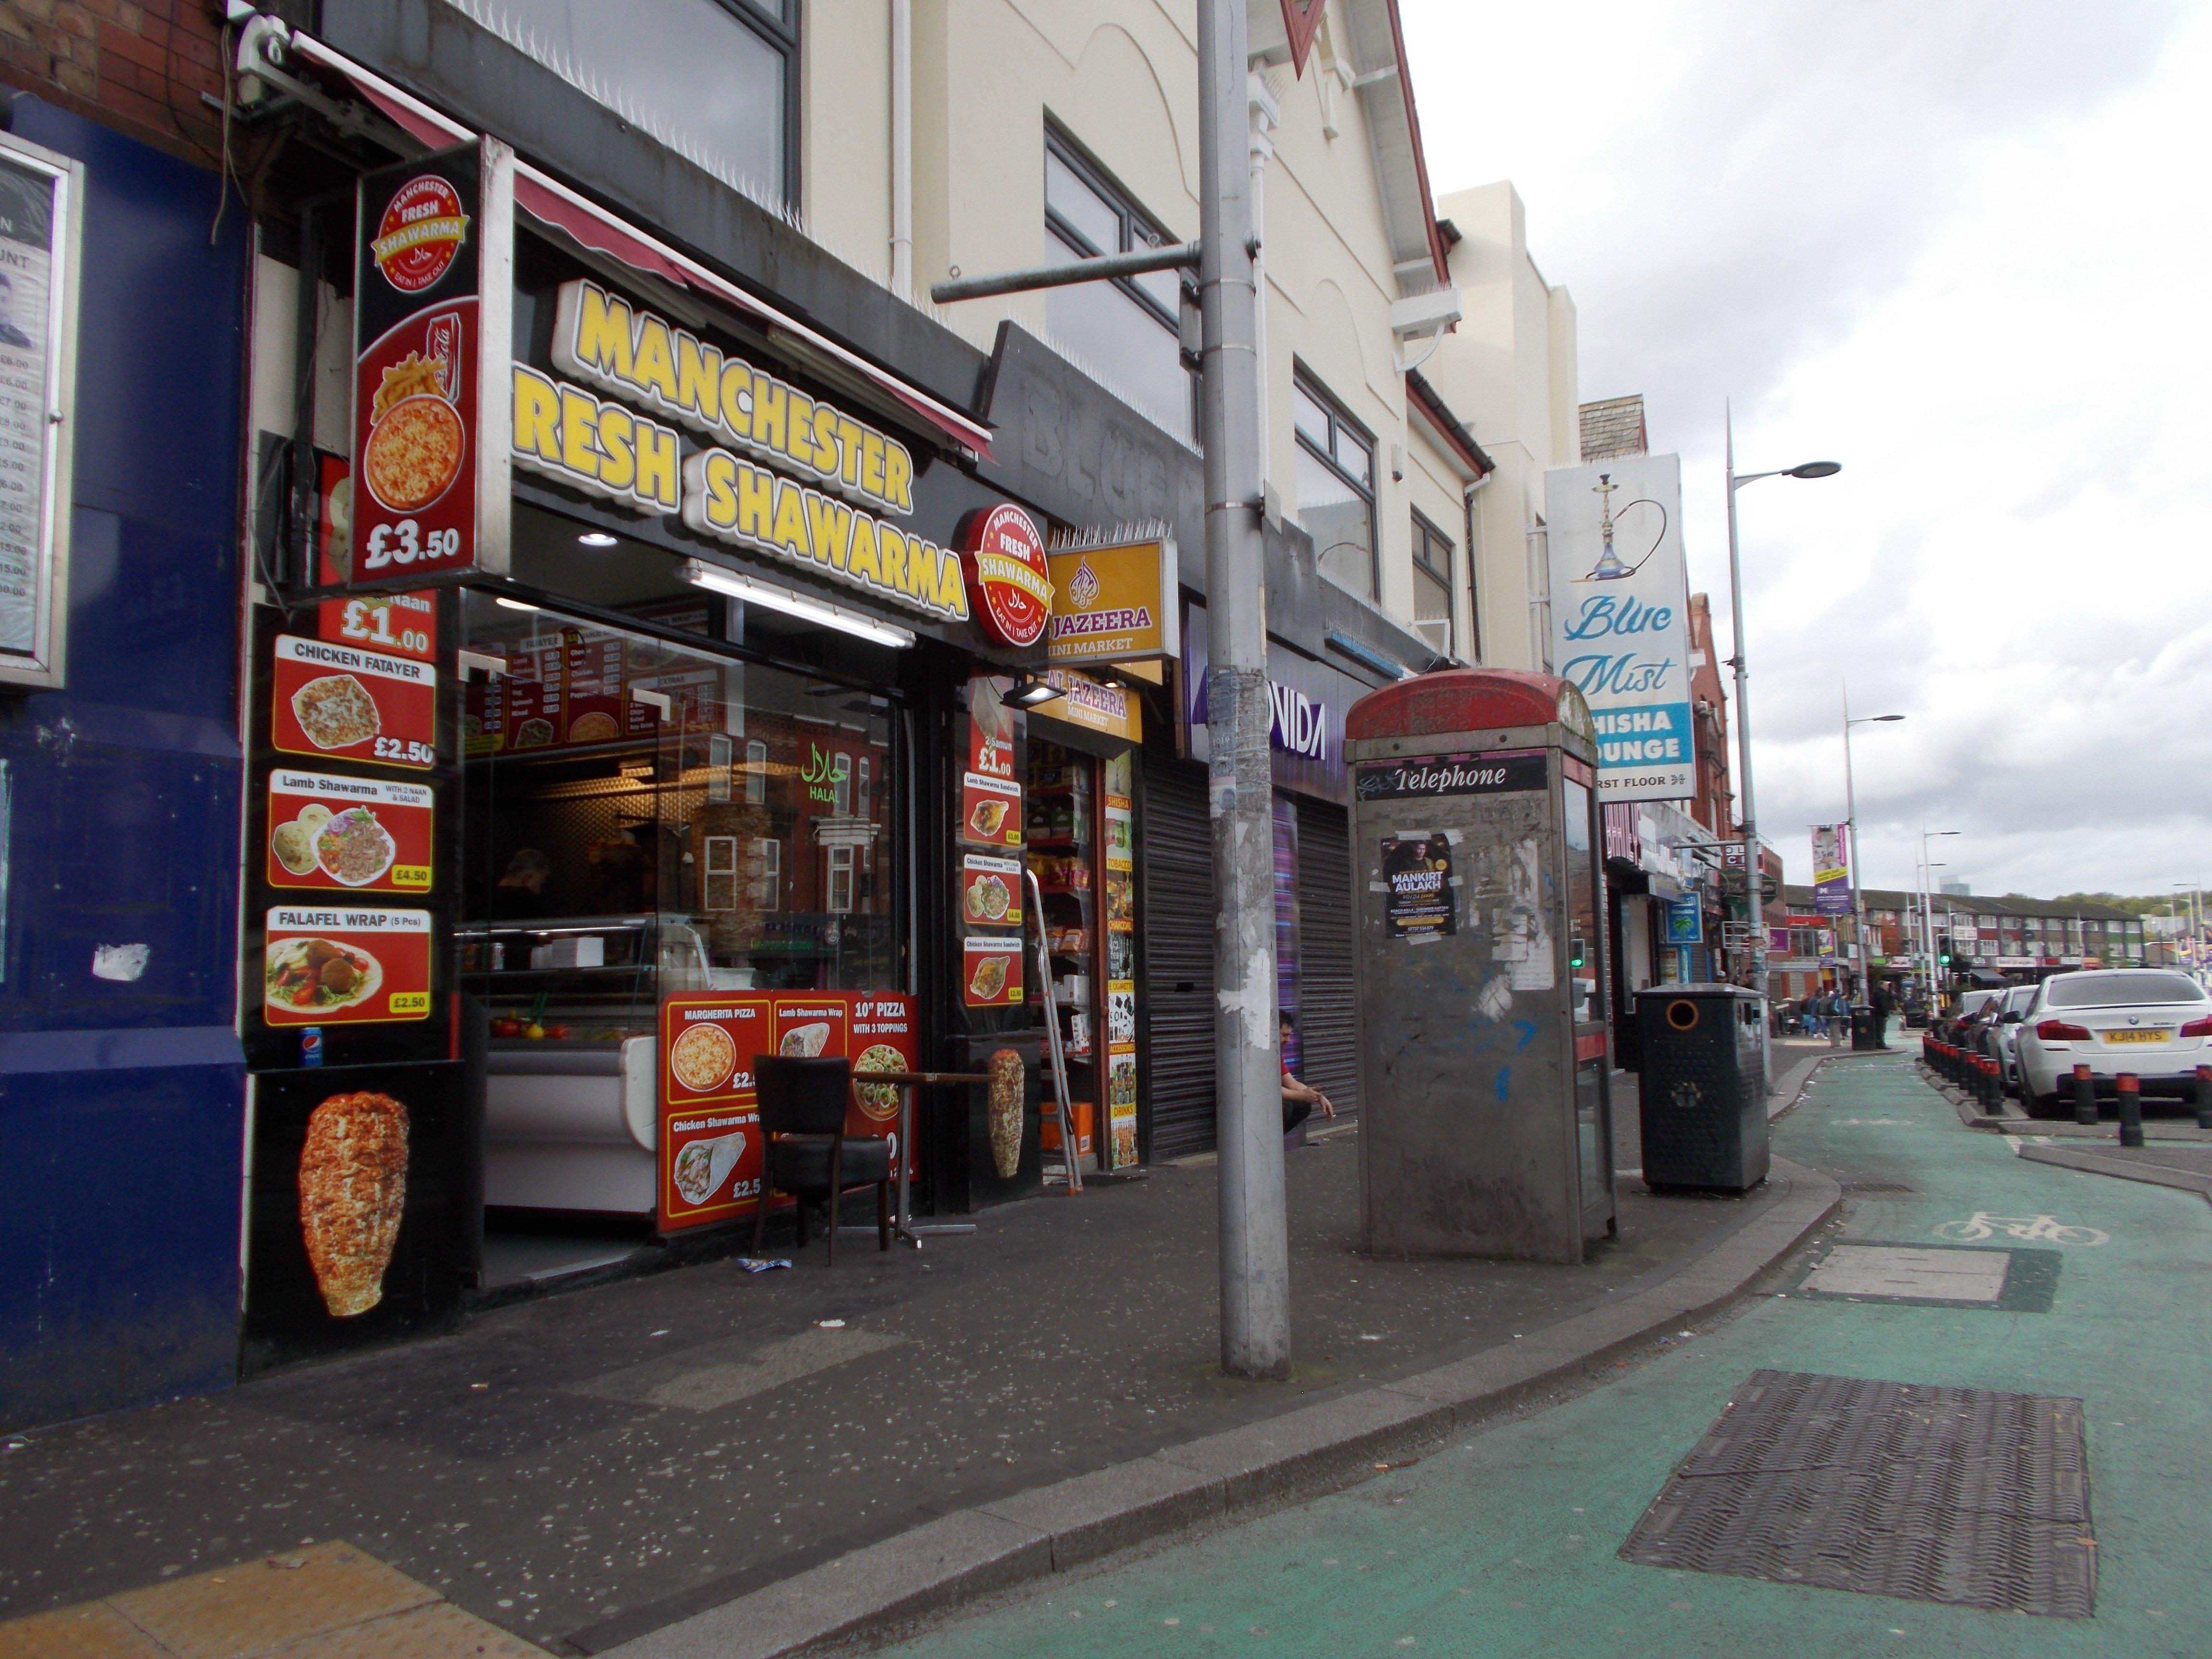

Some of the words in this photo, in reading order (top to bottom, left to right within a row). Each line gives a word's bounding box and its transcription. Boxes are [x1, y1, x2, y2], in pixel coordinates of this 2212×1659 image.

[394, 181, 449, 212] MANCHESTER
[402, 200, 438, 223] FRESH
[380, 221, 459, 255] SHAWARMA
[418, 274, 432, 284] TAKE
[433, 260, 444, 276] OUT
[575, 283, 912, 513] MANCHESTER
[513, 367, 679, 511] RESH
[704, 451, 968, 619] SHAWARMA
[993, 511, 1038, 550] MANCHESTER
[365, 519, 458, 568] £3.50
[1000, 532, 1030, 561] FRESH
[982, 558, 1047, 601] SHAWARMA
[390, 595, 430, 613] Naan
[1008, 588, 1026, 609] حلال
[342, 600, 428, 652] £1.00
[996, 606, 1006, 625] EAT
[1006, 621, 1011, 633] IN
[1016, 625, 1028, 638] TAKE
[1028, 621, 1038, 636] OUT
[1054, 607, 1151, 638] JAZEERA
[1564, 594, 1671, 641] Blue
[1073, 637, 1133, 655] MARKET
[294, 643, 361, 667] CHICKEN
[365, 657, 421, 678] FATAYER
[1562, 653, 1677, 696] Mist
[1068, 675, 1126, 719] JAZEERA
[1068, 706, 1083, 718] MINI
[1083, 709, 1108, 726] MARKET
[1593, 710, 1672, 734] HISHA
[374, 736, 433, 763] £2.50
[985, 736, 990, 745] 2
[991, 737, 1012, 751] Samun
[1598, 738, 1679, 762] UNGE
[802, 741, 848, 783] حلال
[978, 747, 1010, 776] £1.00
[283, 775, 314, 789] Lamb
[319, 779, 378, 795] Shawarma
[385, 784, 402, 793] WITH
[979, 779, 999, 788] Shawarma
[1000, 783, 1018, 793] Sandwich
[1395, 765, 1506, 792] Telephone
[1598, 779, 1619, 789] RST
[1624, 776, 1666, 788] FLOOR
[399, 794, 420, 804] SALAD
[810, 786, 840, 803] HALAL
[1108, 797, 1128, 809] SHISHA
[984, 860, 1003, 868] Shawarma
[1108, 858, 1131, 869] TOBACCO
[396, 870, 428, 882] £4.50
[1392, 871, 1443, 884] MANKIRT
[1395, 880, 1441, 892] AULAKH
[279, 913, 341, 926] FALAFEL
[346, 914, 387, 927] WRAP
[391, 917, 400, 926] (5
[402, 917, 421, 926] Pcs)
[1109, 920, 1132, 930] CHARCOAL
[394, 997, 425, 1008] £2.50
[877, 1002, 905, 1017] PIZZA
[685, 1009, 733, 1020] MARGHERITA
[734, 1009, 755, 1018] PIZZA
[779, 1009, 795, 1017] Lamb
[797, 1009, 827, 1017] Shawarma
[828, 1009, 842, 1018] Wrap
[854, 1023, 870, 1034] WITH
[872, 1024, 876, 1033] 3
[878, 1023, 907, 1033] TOPPINGS
[2139, 1032, 2163, 1040] HYS
[1110, 1043, 1135, 1053] ACCESSORIES
[733, 1071, 756, 1089] £2.
[1114, 1105, 1133, 1117] DRINKS
[673, 1121, 705, 1133] Chicken
[707, 1115, 746, 1128] Shawarma
[747, 1114, 760, 1123] Wr
[733, 1178, 760, 1198] £2.5
